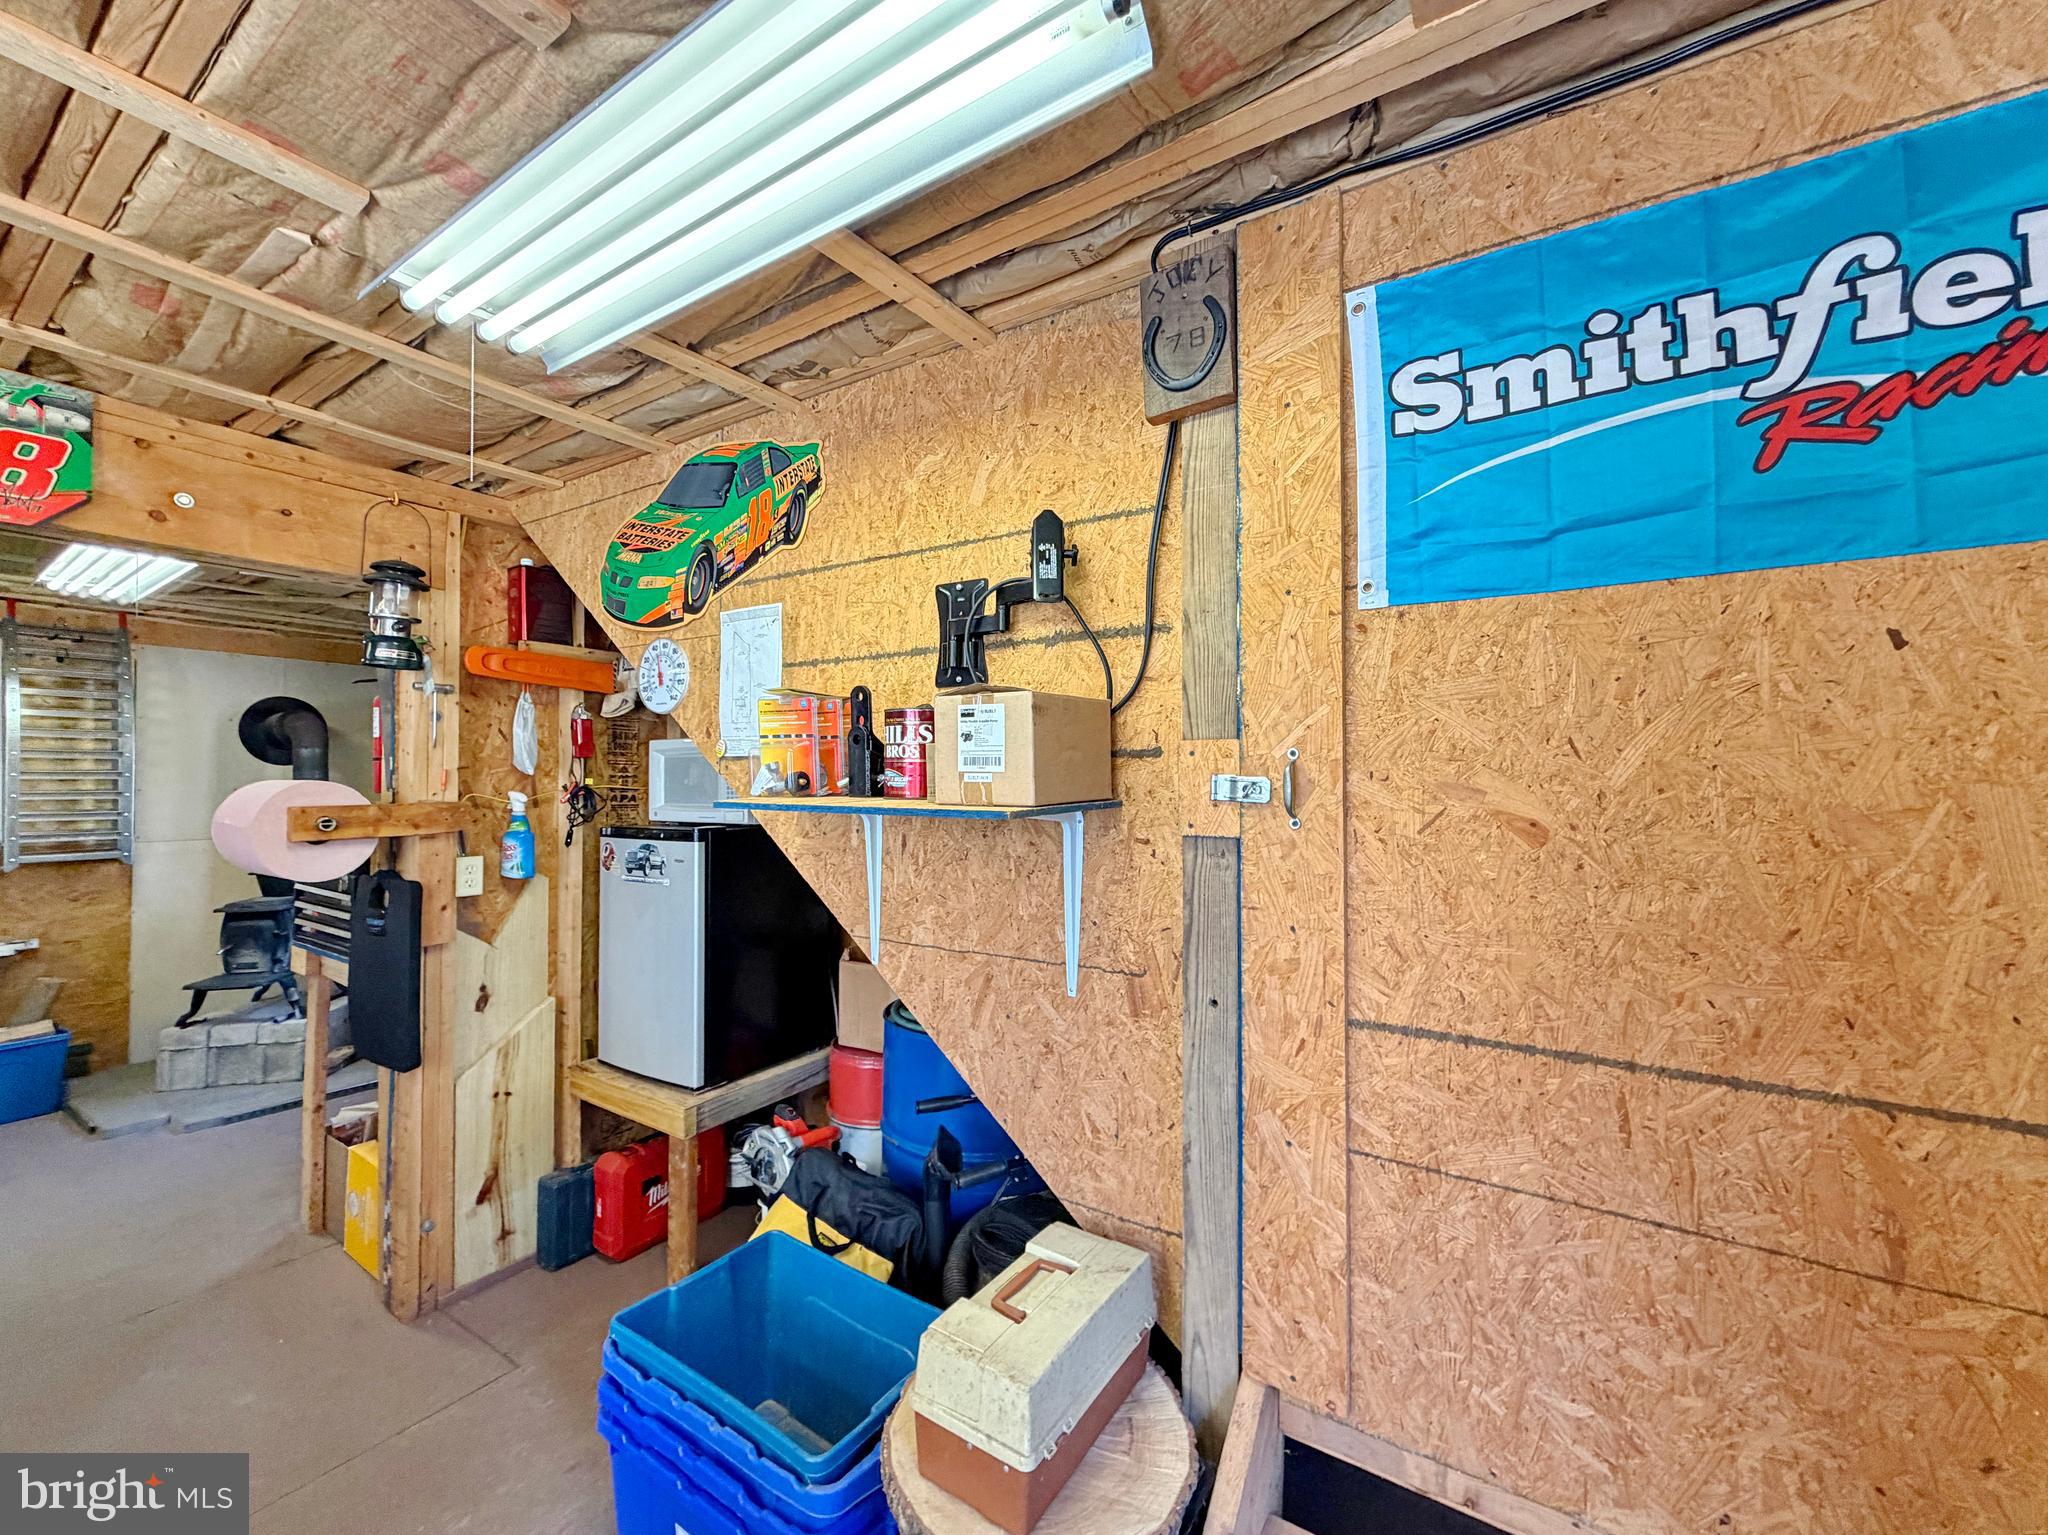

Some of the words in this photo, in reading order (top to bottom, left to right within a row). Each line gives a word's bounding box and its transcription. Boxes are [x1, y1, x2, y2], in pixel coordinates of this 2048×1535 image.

[775, 456, 816, 495] INTERSTATE
[746, 487, 774, 551] 18
[624, 521, 690, 540] INTERSTATE
[616, 532, 675, 549] BATTERIES
[651, 644, 659, 652] 40
[884, 724, 934, 744] HILLS
[886, 744, 920, 758] BROS
[609, 794, 637, 803] APA
